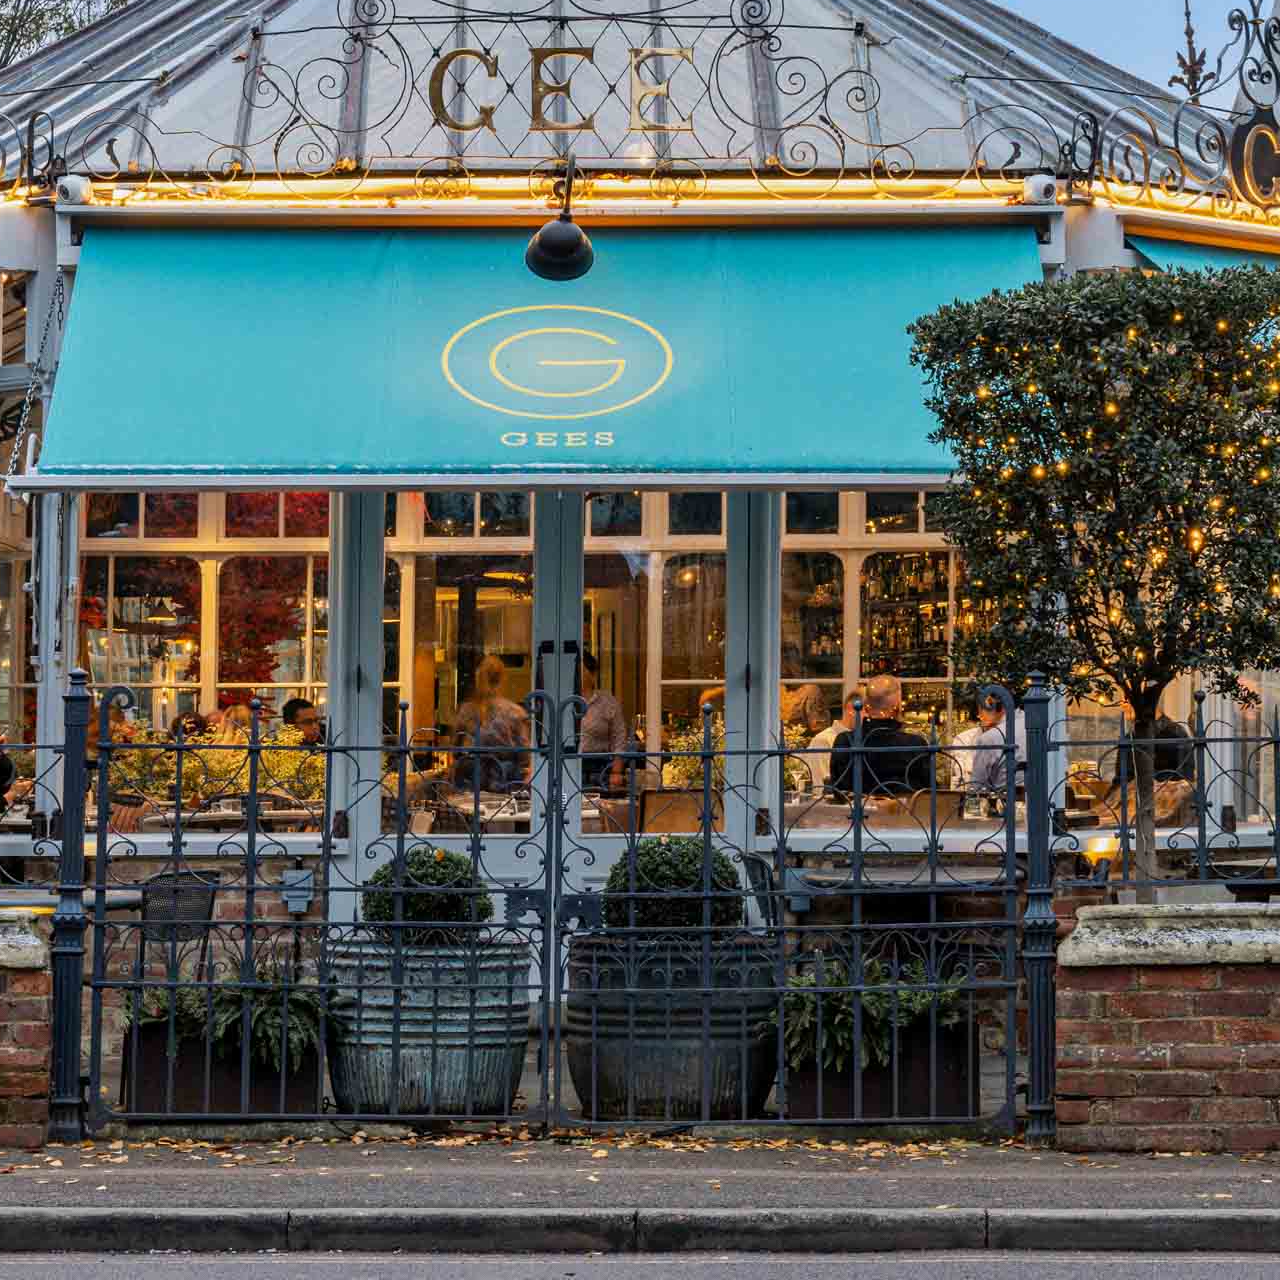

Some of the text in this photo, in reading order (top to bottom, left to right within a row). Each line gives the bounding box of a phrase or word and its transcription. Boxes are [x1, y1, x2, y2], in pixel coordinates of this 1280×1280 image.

[428, 47, 695, 132] GEE
[489, 327, 626, 398] G
[500, 431, 616, 448] GEES
